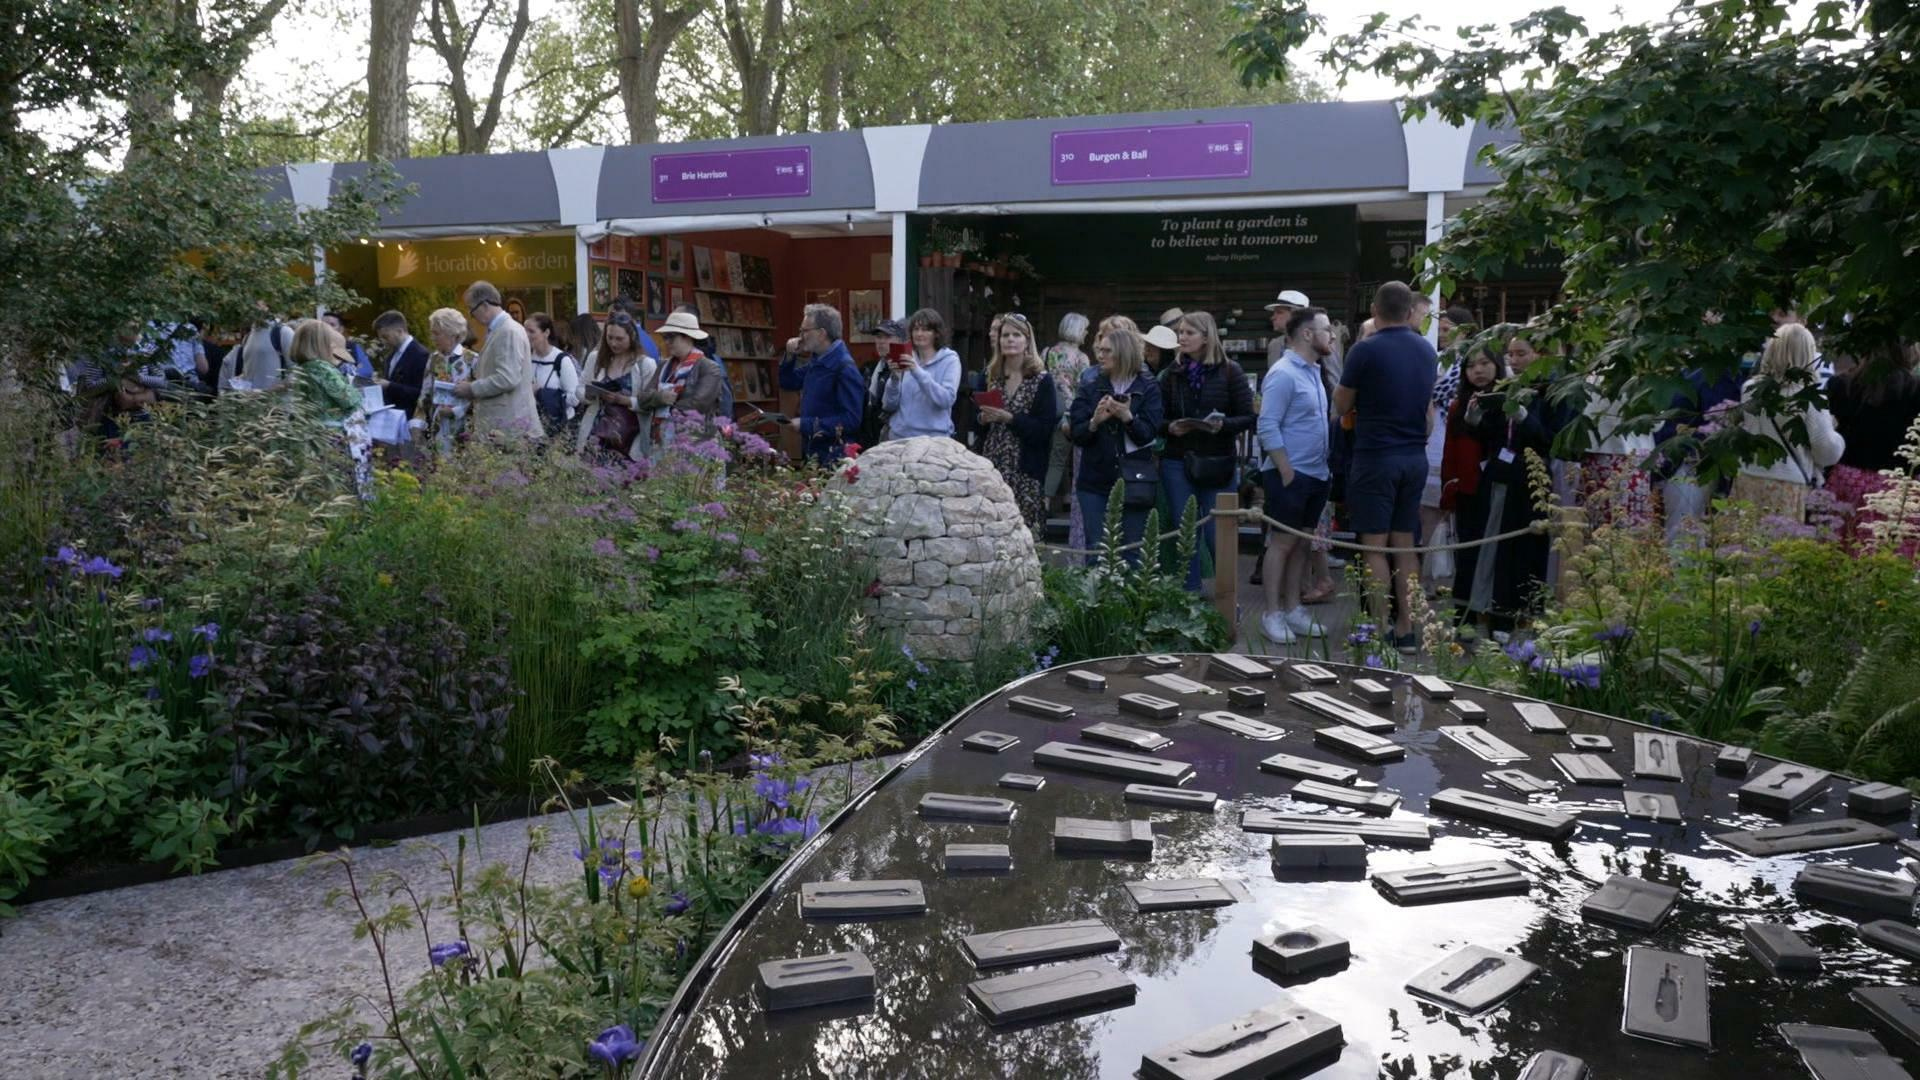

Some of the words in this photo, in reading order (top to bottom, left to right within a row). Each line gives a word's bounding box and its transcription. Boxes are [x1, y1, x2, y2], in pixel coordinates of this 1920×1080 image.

[1214, 143, 1229, 152] RHS
[1061, 153, 1074, 163] 310
[1089, 152, 1120, 163] Burgon
[1122, 151, 1130, 160] &
[1131, 150, 1148, 160] Ball
[681, 172, 696, 181] Brie
[697, 170, 728, 179] Harrison
[1161, 218, 1179, 231] To
[1181, 217, 1221, 233] plant
[1224, 219, 1234, 229] a
[1237, 215, 1291, 232] garden
[1294, 213, 1308, 227] is
[1151, 237, 1165, 248] to
[1169, 234, 1218, 248] believe
[1222, 233, 1237, 246] in
[1241, 233, 1318, 246] tomorrow
[426, 253, 498, 273] Horatio's
[503, 251, 568, 272] Garden
